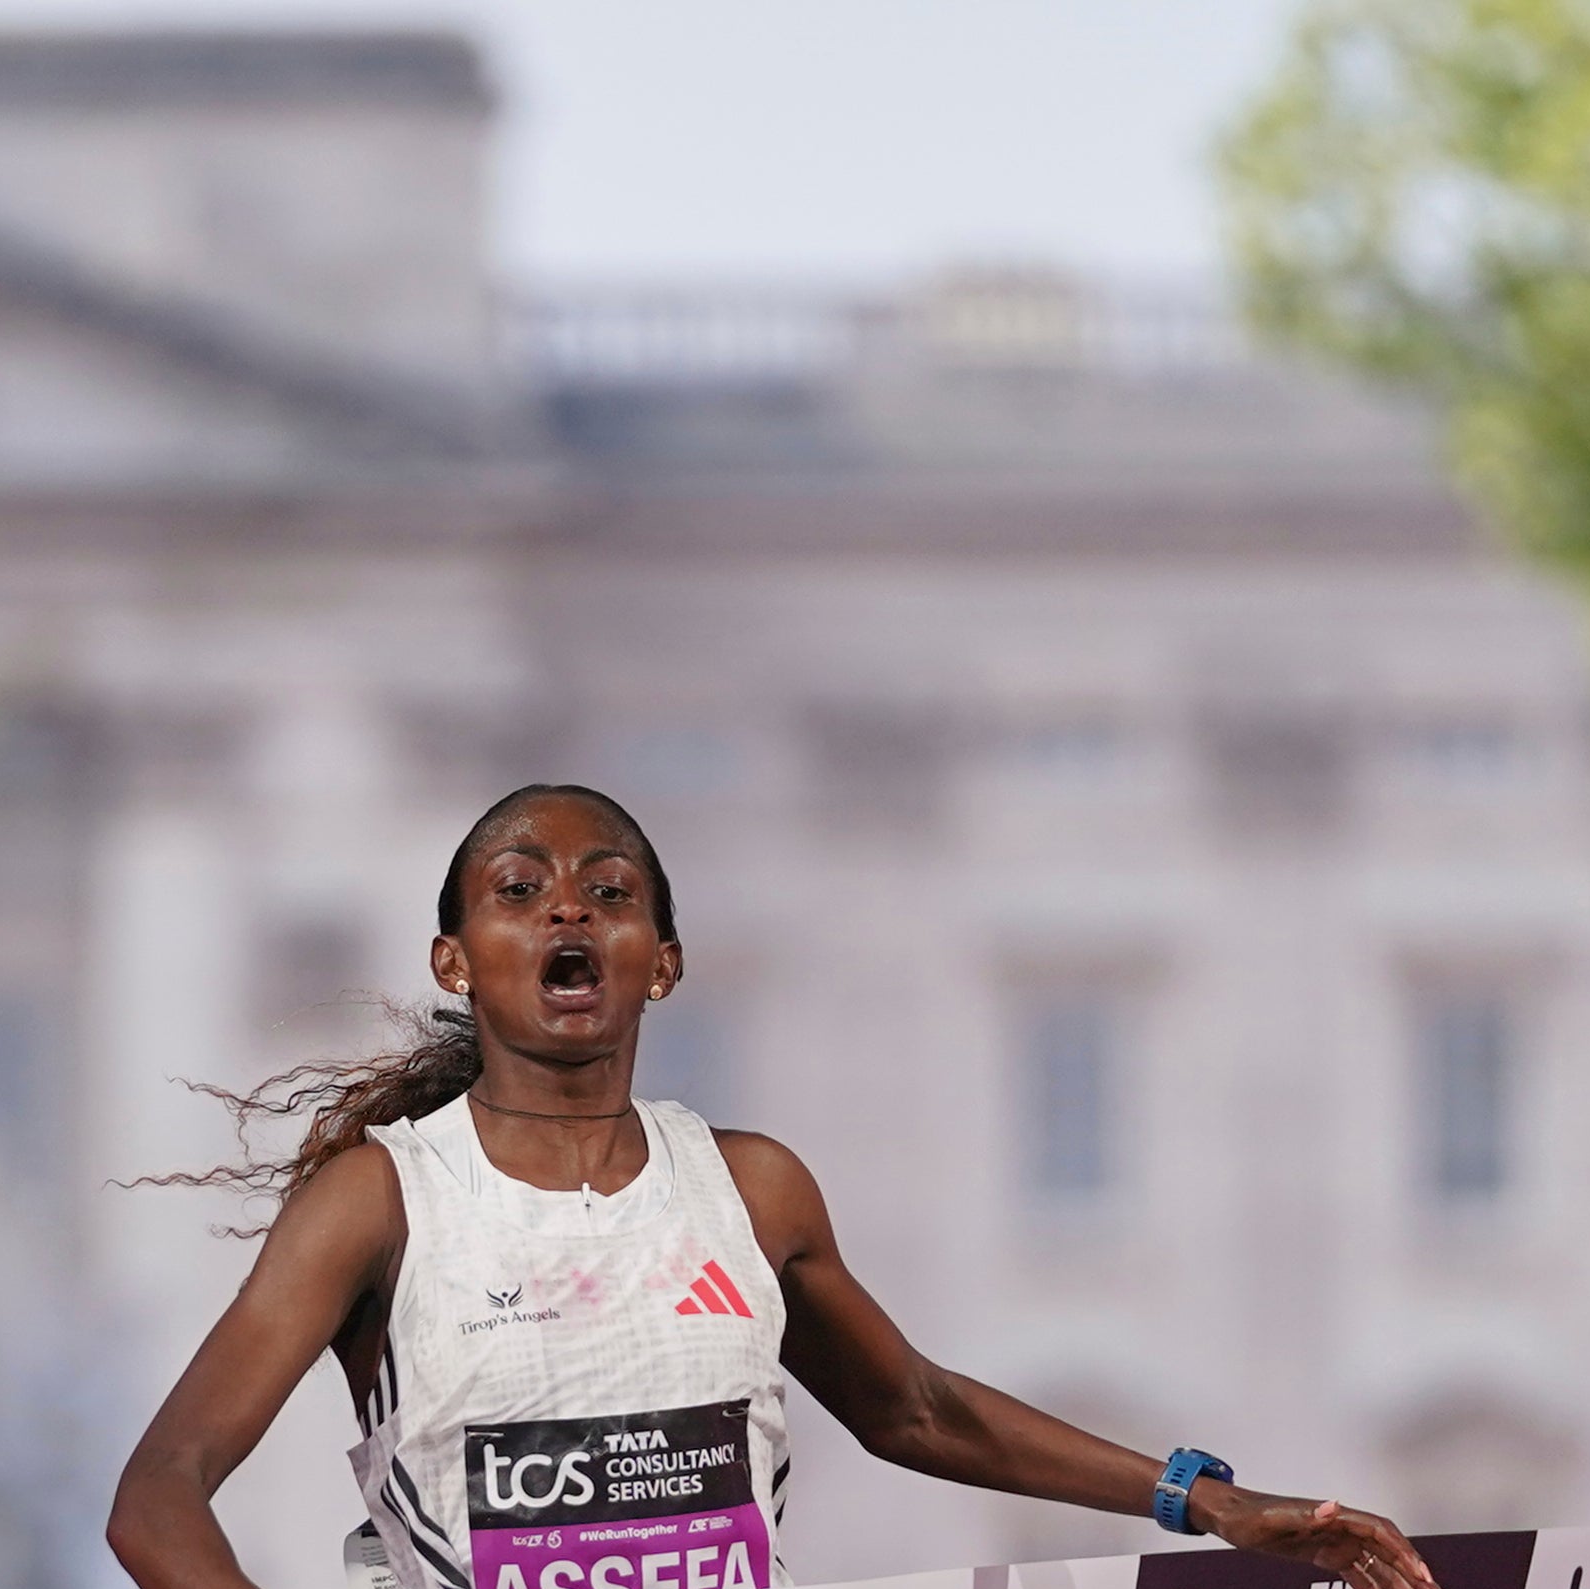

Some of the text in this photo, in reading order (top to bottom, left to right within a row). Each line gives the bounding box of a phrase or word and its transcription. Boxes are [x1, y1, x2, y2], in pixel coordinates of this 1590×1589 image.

[458, 1307, 561, 1335] Tirop's Angels
[604, 1430, 668, 1454] TATA
[483, 1443, 735, 1510] tcs CONSULTANCY
[607, 1474, 703, 1502] SERVICES
[579, 1523, 678, 1542] #WeRunTogether
